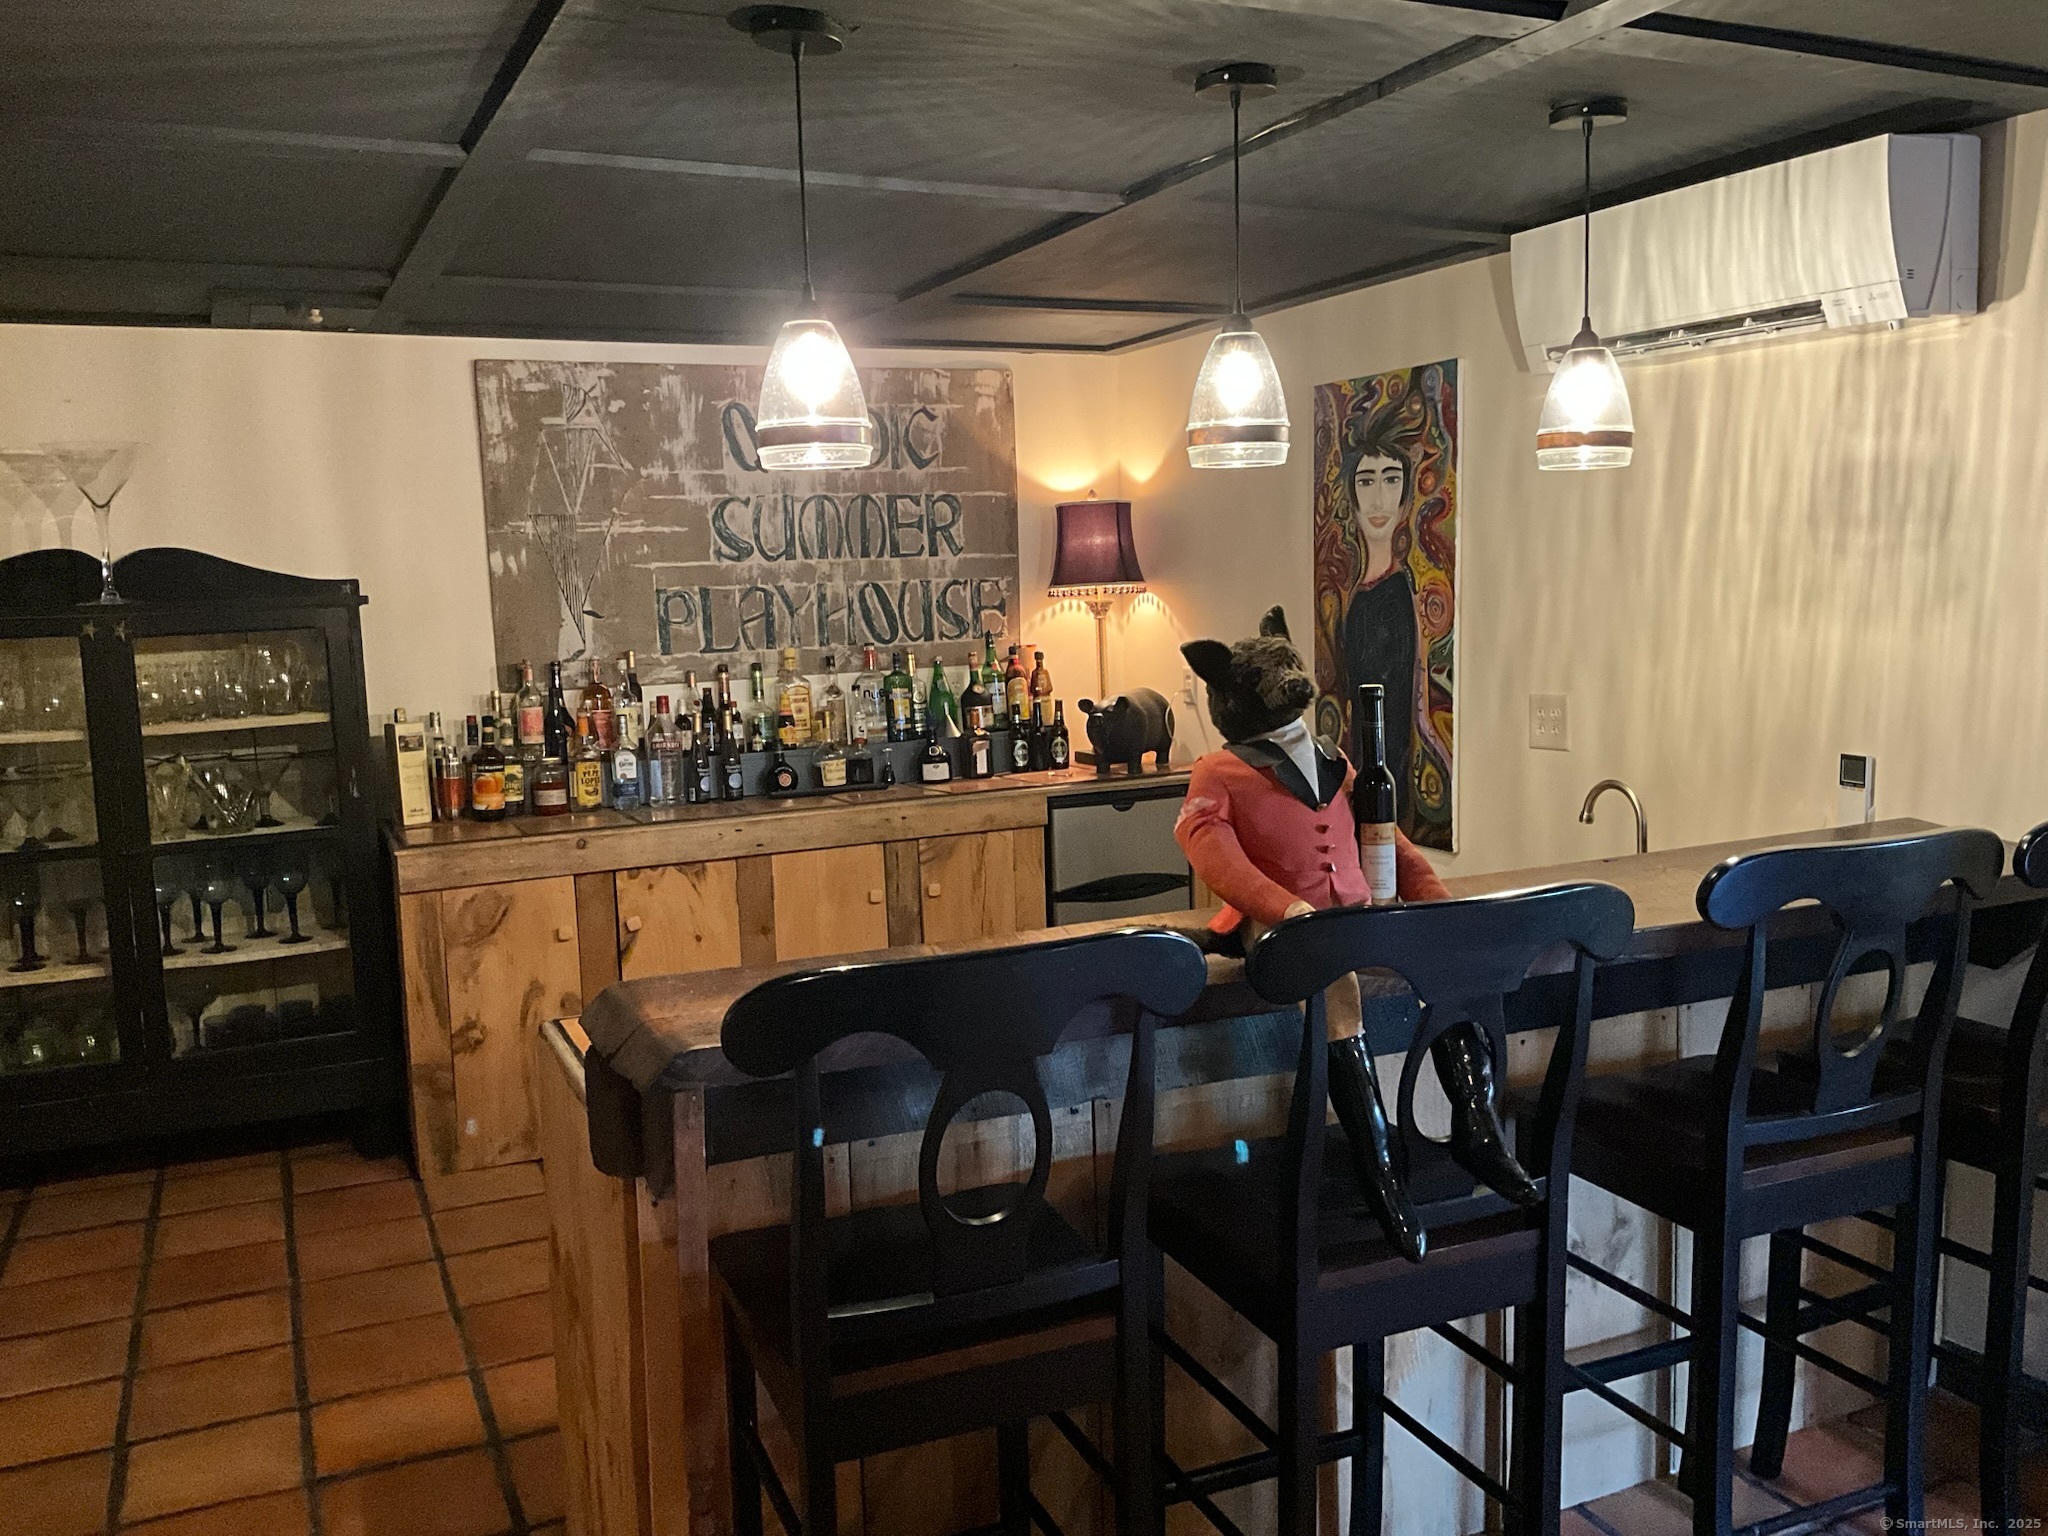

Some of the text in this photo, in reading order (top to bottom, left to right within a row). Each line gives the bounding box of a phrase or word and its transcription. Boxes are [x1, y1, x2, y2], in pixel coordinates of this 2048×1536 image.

[712, 494, 964, 562] SUMMER
[654, 580, 1007, 655] PLAYHOUSE
[582, 769, 599, 777] PEPE
